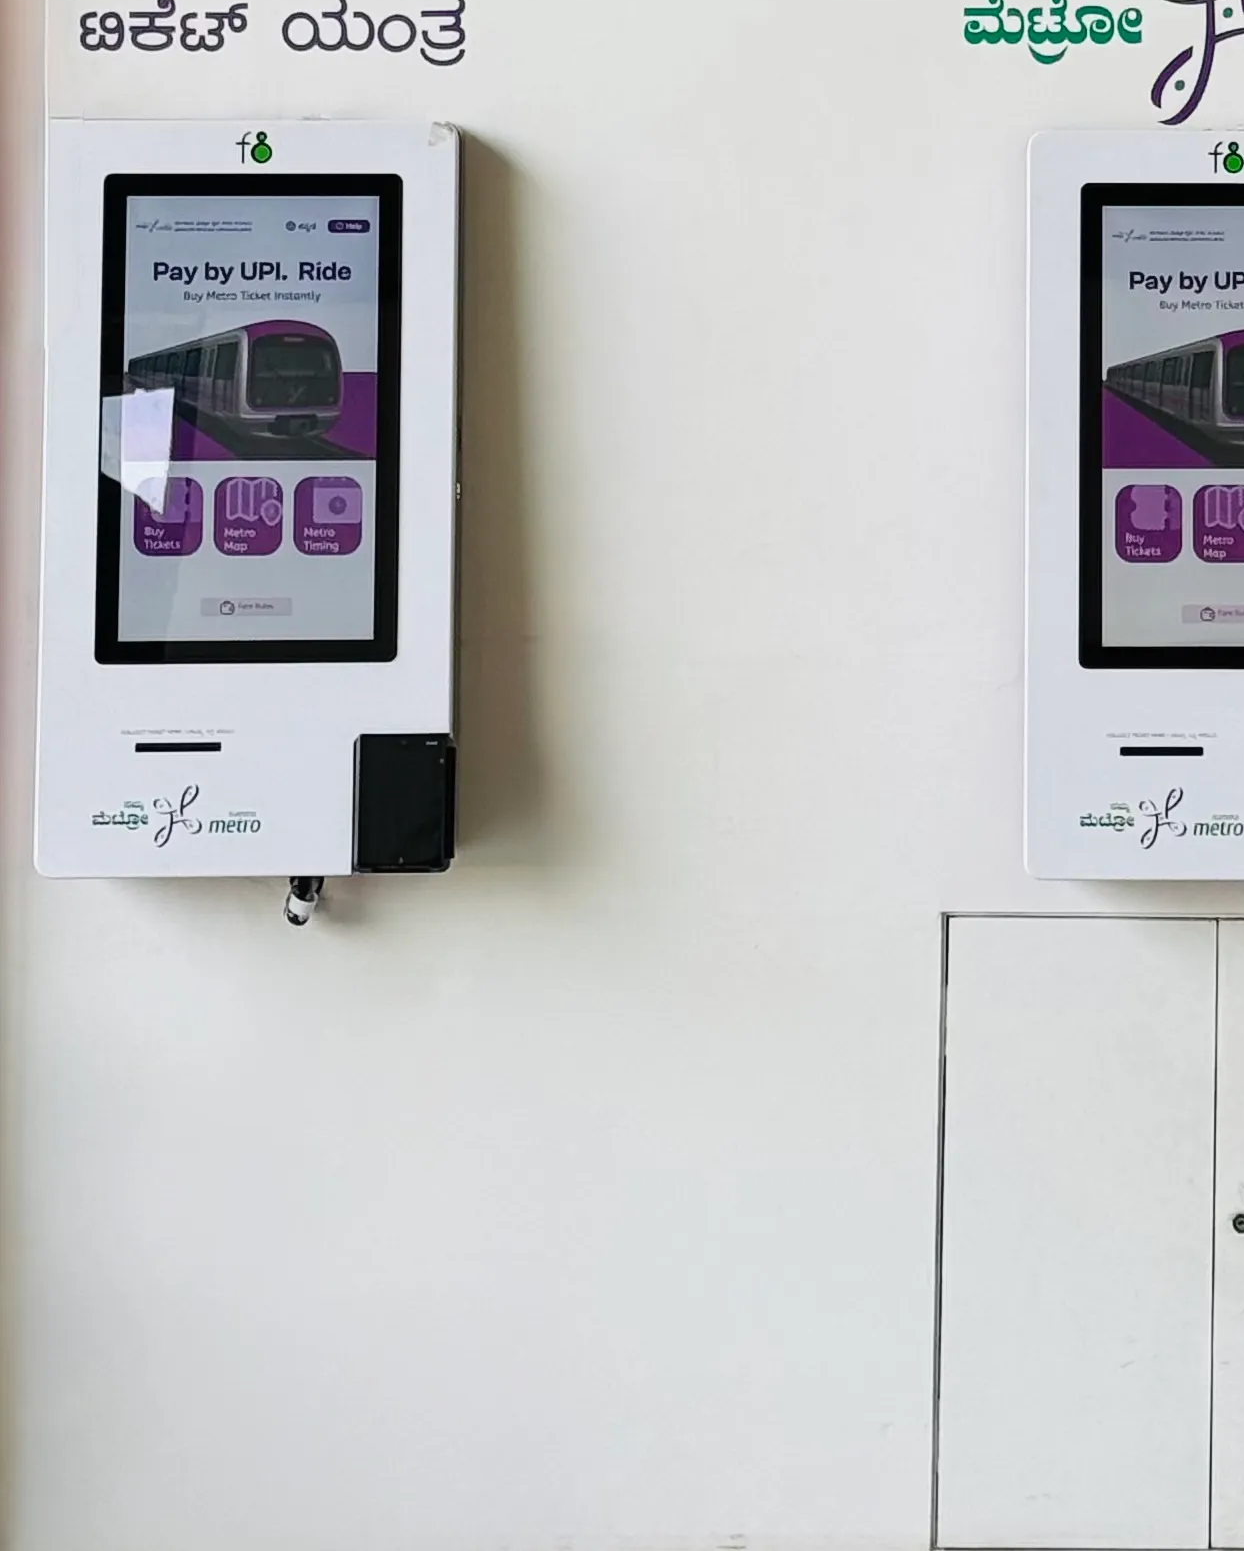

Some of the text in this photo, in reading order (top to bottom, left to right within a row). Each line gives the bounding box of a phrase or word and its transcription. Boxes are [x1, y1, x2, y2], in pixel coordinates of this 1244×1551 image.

[153, 261, 352, 285] Pay by UPI. Ride
[1129, 271, 1173, 294] Pay
[1179, 271, 1208, 294] by
[183, 291, 321, 303] Buy Metro Ticket Instantly
[1159, 300, 1178, 312] Buy
[1181, 300, 1212, 310] Metro
[1215, 300, 1244, 310] Ticket
[144, 526, 165, 539] Buy
[224, 528, 256, 538] Metro
[304, 528, 336, 538] Metro
[144, 539, 181, 550] Tickets
[1126, 533, 1145, 545] Buy
[1203, 535, 1235, 546] Metro
[224, 541, 248, 553] Map
[304, 541, 340, 553] Timing
[1126, 545, 1161, 556] Tickets
[1203, 548, 1227, 560] Map
[208, 818, 262, 833] metro
[1193, 821, 1244, 837] metro
